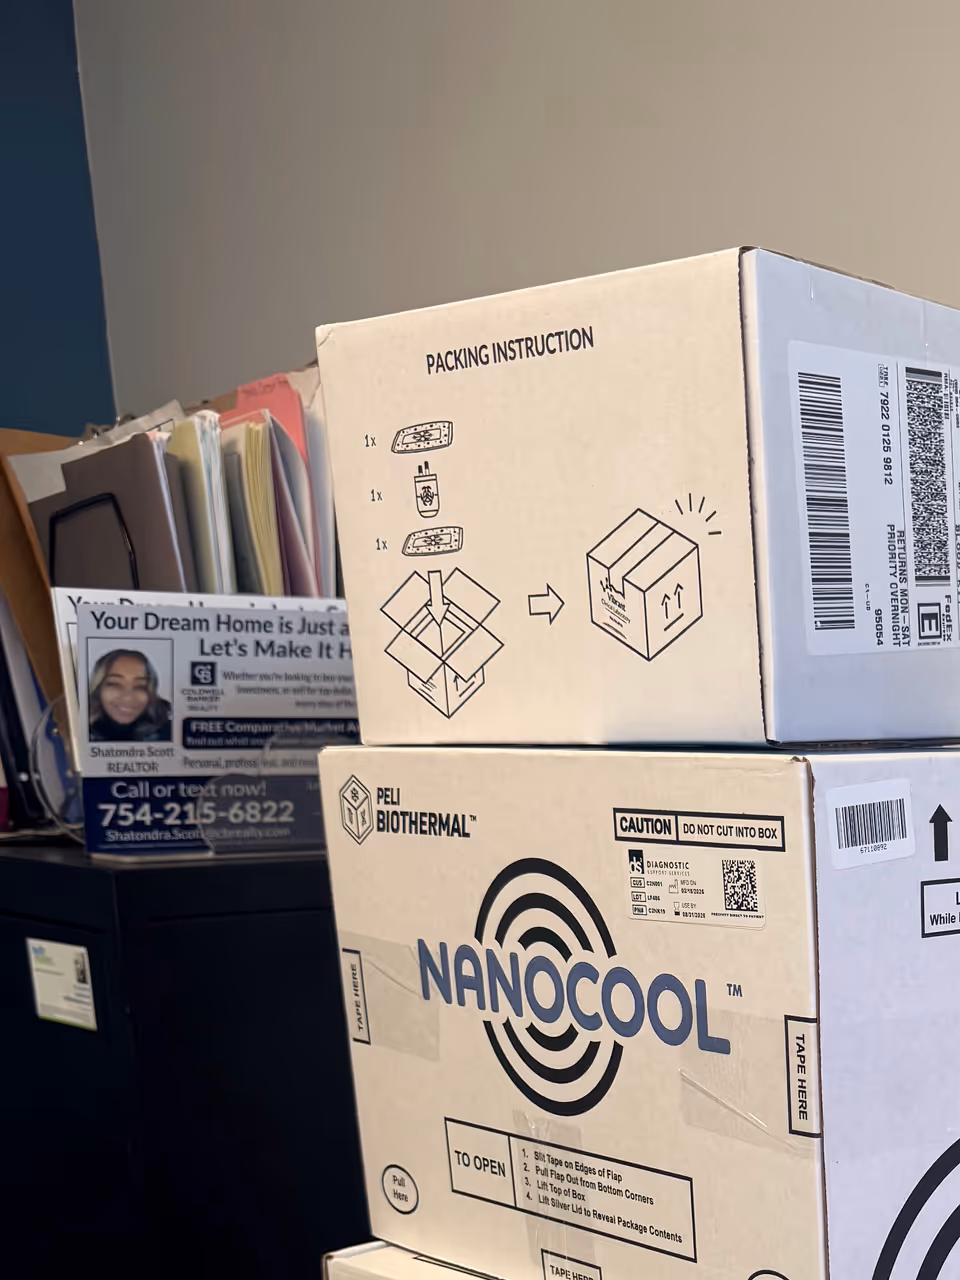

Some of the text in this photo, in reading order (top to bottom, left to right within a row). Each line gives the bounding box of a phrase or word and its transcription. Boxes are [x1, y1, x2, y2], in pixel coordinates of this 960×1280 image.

[425, 326, 594, 375] PACKING INSTRUCTION
[880, 392, 893, 485] 7922 0125 9812
[886, 524, 897, 579] PRIORITY
[897, 530, 907, 585] RETURNS
[91, 611, 335, 636] Your Dream Home is Just
[874, 609, 883, 646] 95054
[200, 638, 333, 659] Let's Make It
[192, 722, 223, 732] FREE
[148, 747, 174, 758] Scott
[107, 762, 159, 773] REALTOR
[111, 781, 174, 798] Call or
[377, 787, 400, 805] PELI
[98, 801, 295, 827] 754-215-6822
[620, 817, 777, 839] CAUTION DO NOT CUT INTO BOX
[647, 860, 690, 870] DIAGNOSTIC
[930, 913, 956, 926] While
[351, 963, 364, 1032] TAPE HERE
[796, 1034, 808, 1120] TAPE HERE
[454, 1150, 506, 1177] TO OPEN
[547, 1154, 623, 1182] Tape Edges Flap
[393, 1175, 405, 1187] Pull
[550, 1169, 654, 1205] Flap Out from Bottom Corners
[550, 1184, 586, 1201] Top Box
[393, 1189, 408, 1202] Here
[551, 1198, 683, 1243] Silver Reveal Package Contents
[550, 1265, 571, 1280] TAPE
